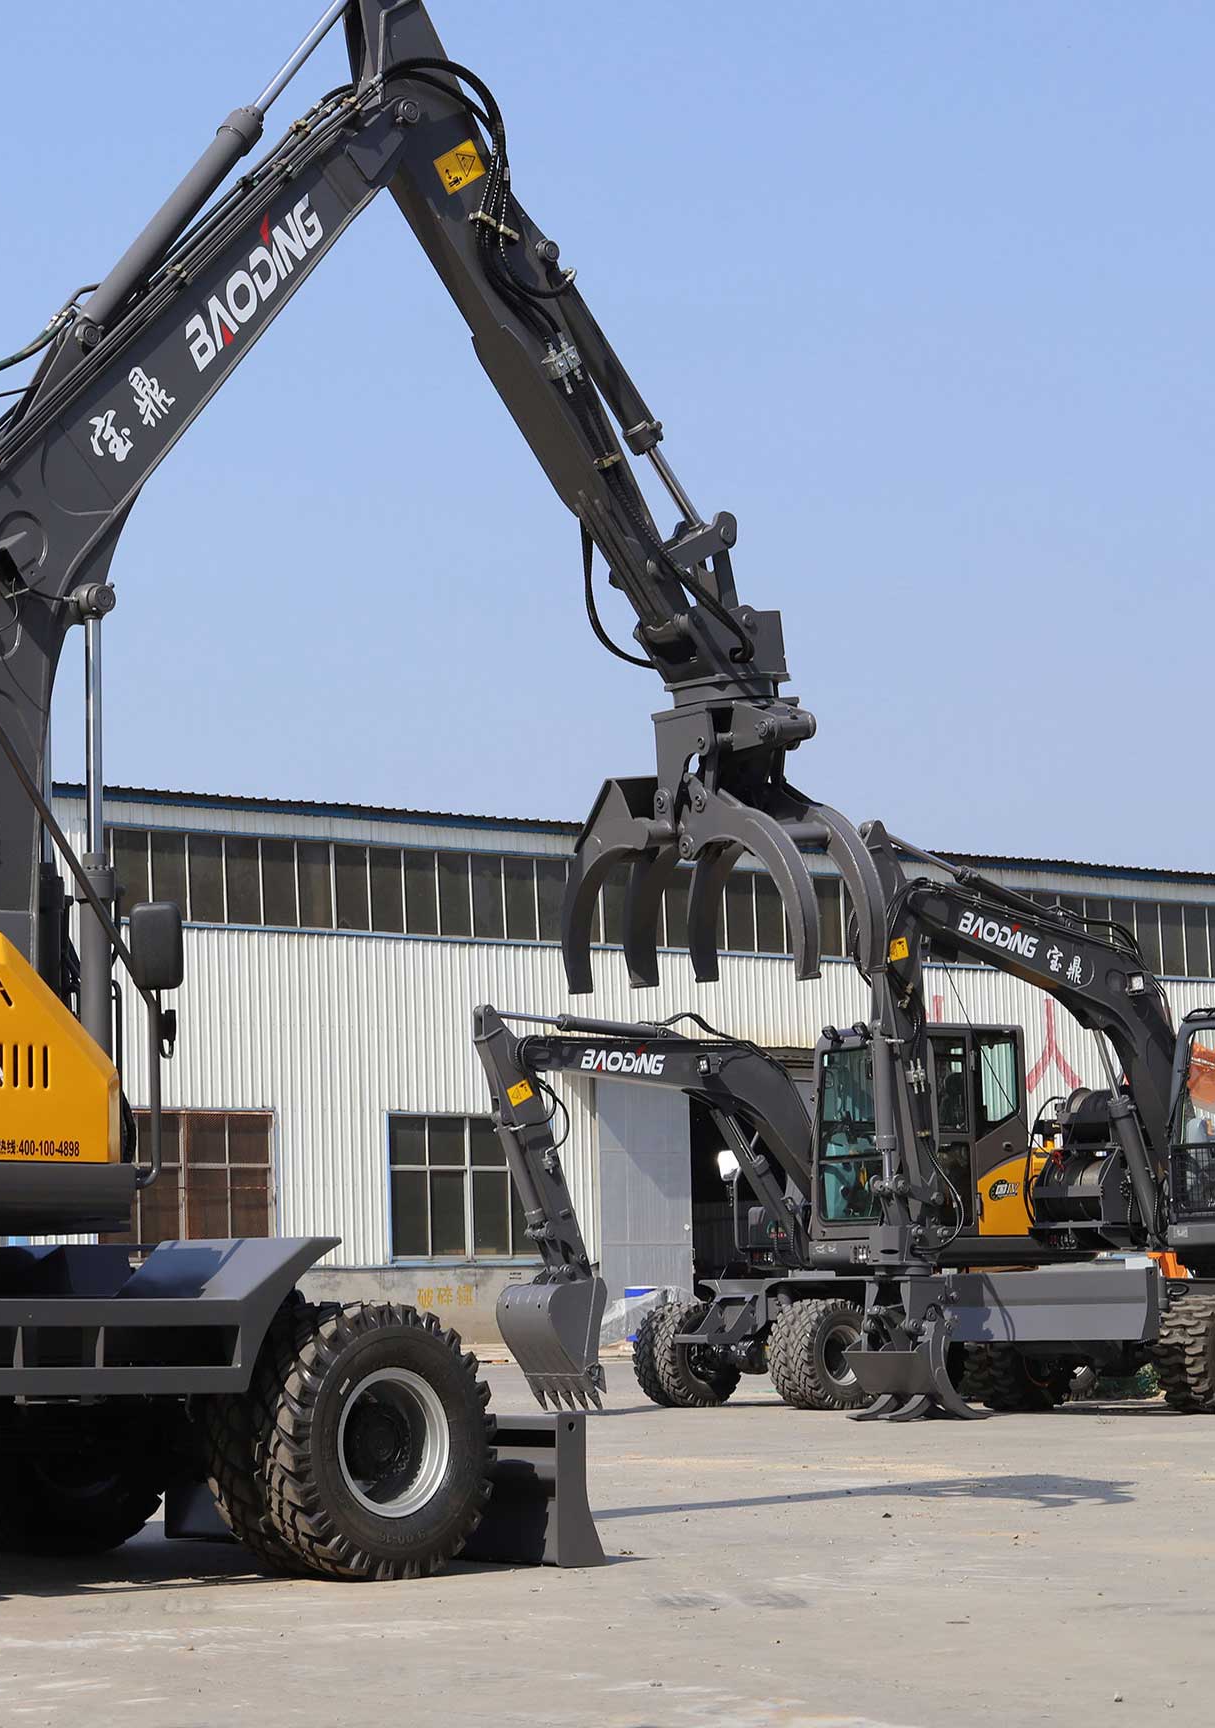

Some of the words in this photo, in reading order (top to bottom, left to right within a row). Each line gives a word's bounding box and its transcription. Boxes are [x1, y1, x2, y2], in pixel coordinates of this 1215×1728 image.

[88, 366, 177, 463] 宝鼎
[185, 193, 325, 373] BAODING
[958, 911, 1040, 959] BAODING
[1046, 944, 1083, 985] 宝鼎
[580, 1043, 666, 1076] BAODING
